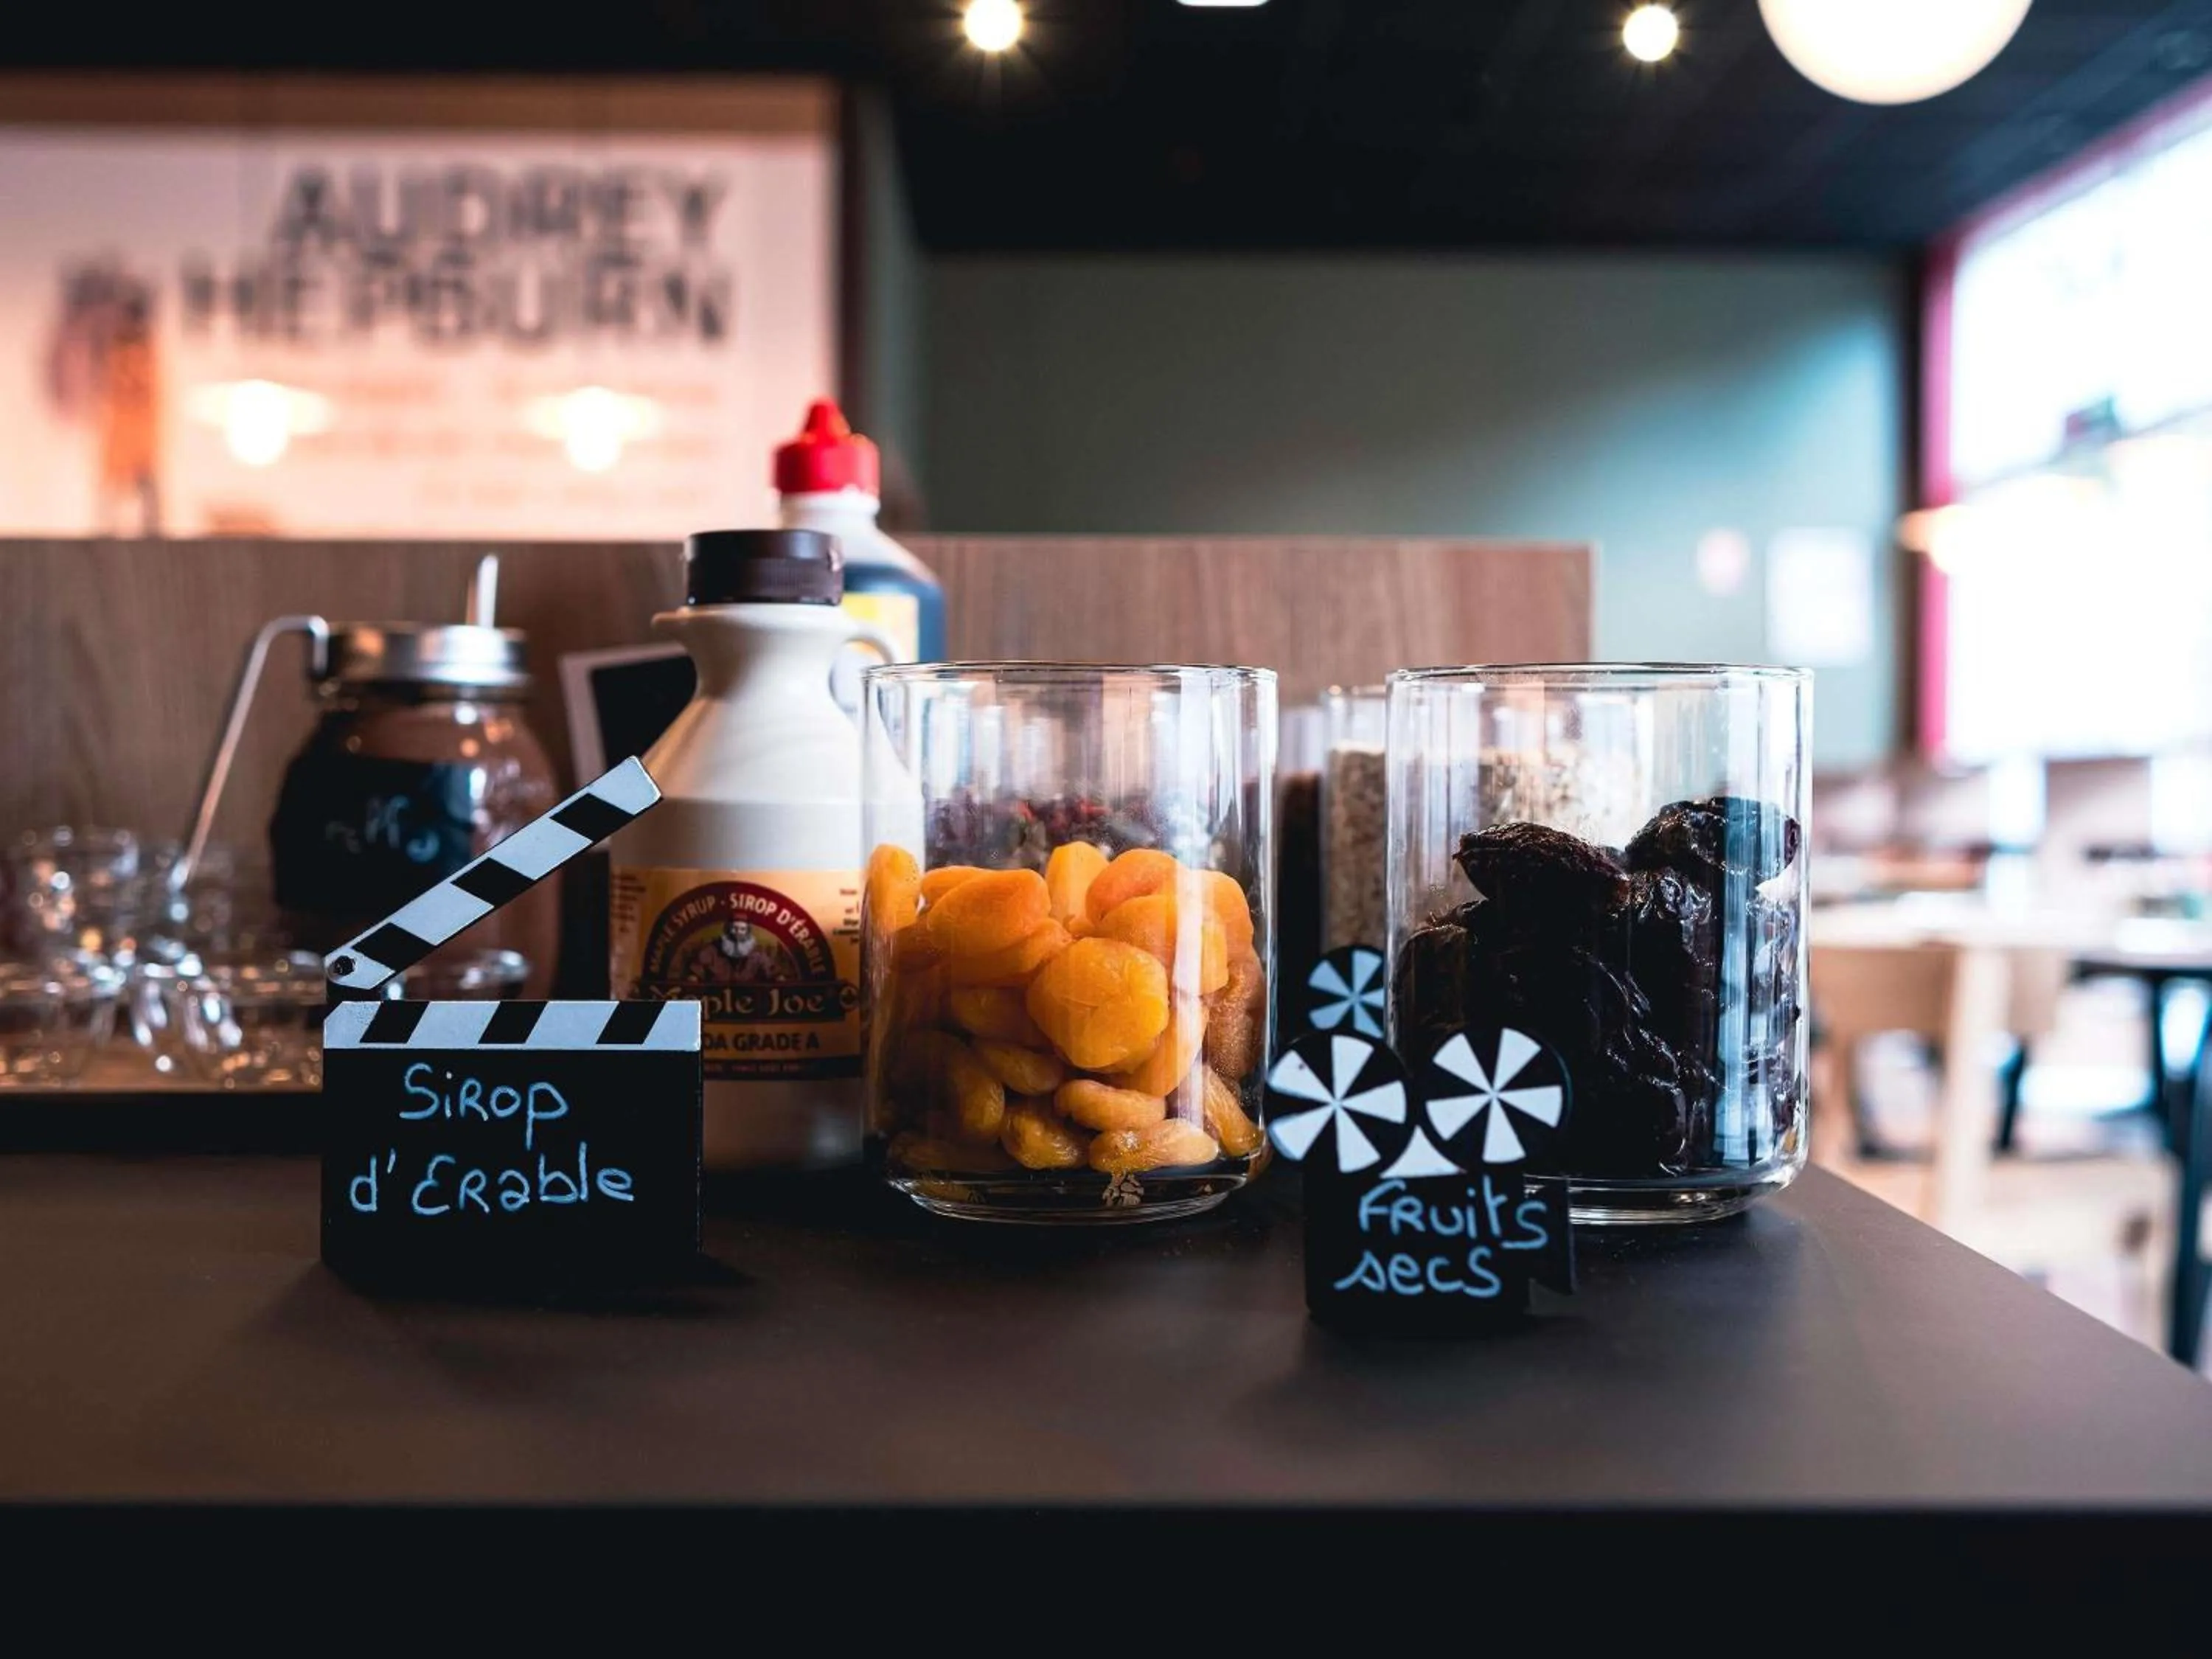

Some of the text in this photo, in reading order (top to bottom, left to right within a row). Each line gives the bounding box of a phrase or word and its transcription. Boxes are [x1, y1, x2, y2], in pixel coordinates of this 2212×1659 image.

[270, 165, 726, 246] AUDREY
[178, 252, 731, 344] HEPBURN
[670, 894, 716, 928] SYRUP
[729, 892, 778, 917] SIROP
[649, 984, 824, 1020] ple Joe
[733, 1032, 801, 1051] GRADE
[806, 1031, 820, 1050] A
